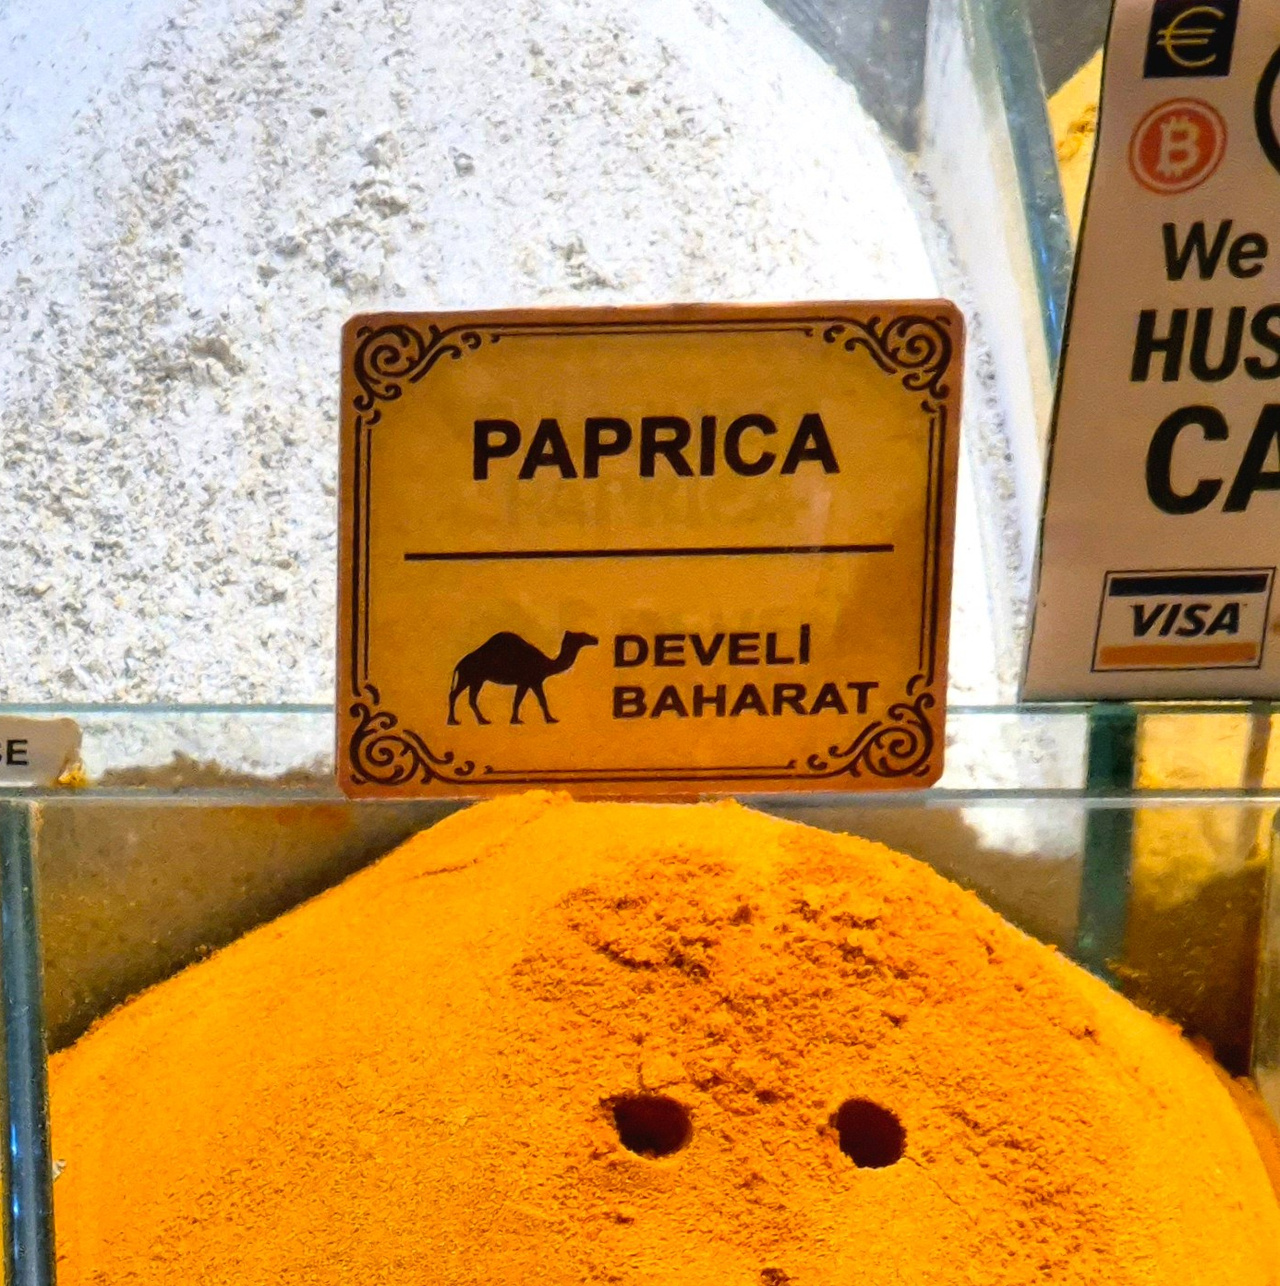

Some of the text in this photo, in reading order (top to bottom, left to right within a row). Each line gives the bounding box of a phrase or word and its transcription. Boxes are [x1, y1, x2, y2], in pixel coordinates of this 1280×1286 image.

[1162, 220, 1267, 281] We
[1130, 305, 1280, 383] HUS
[472, 413, 840, 480] PAPRICA
[1145, 404, 1280, 515] CA
[1131, 603, 1239, 637] VISA
[612, 682, 878, 719] BAHARAT
